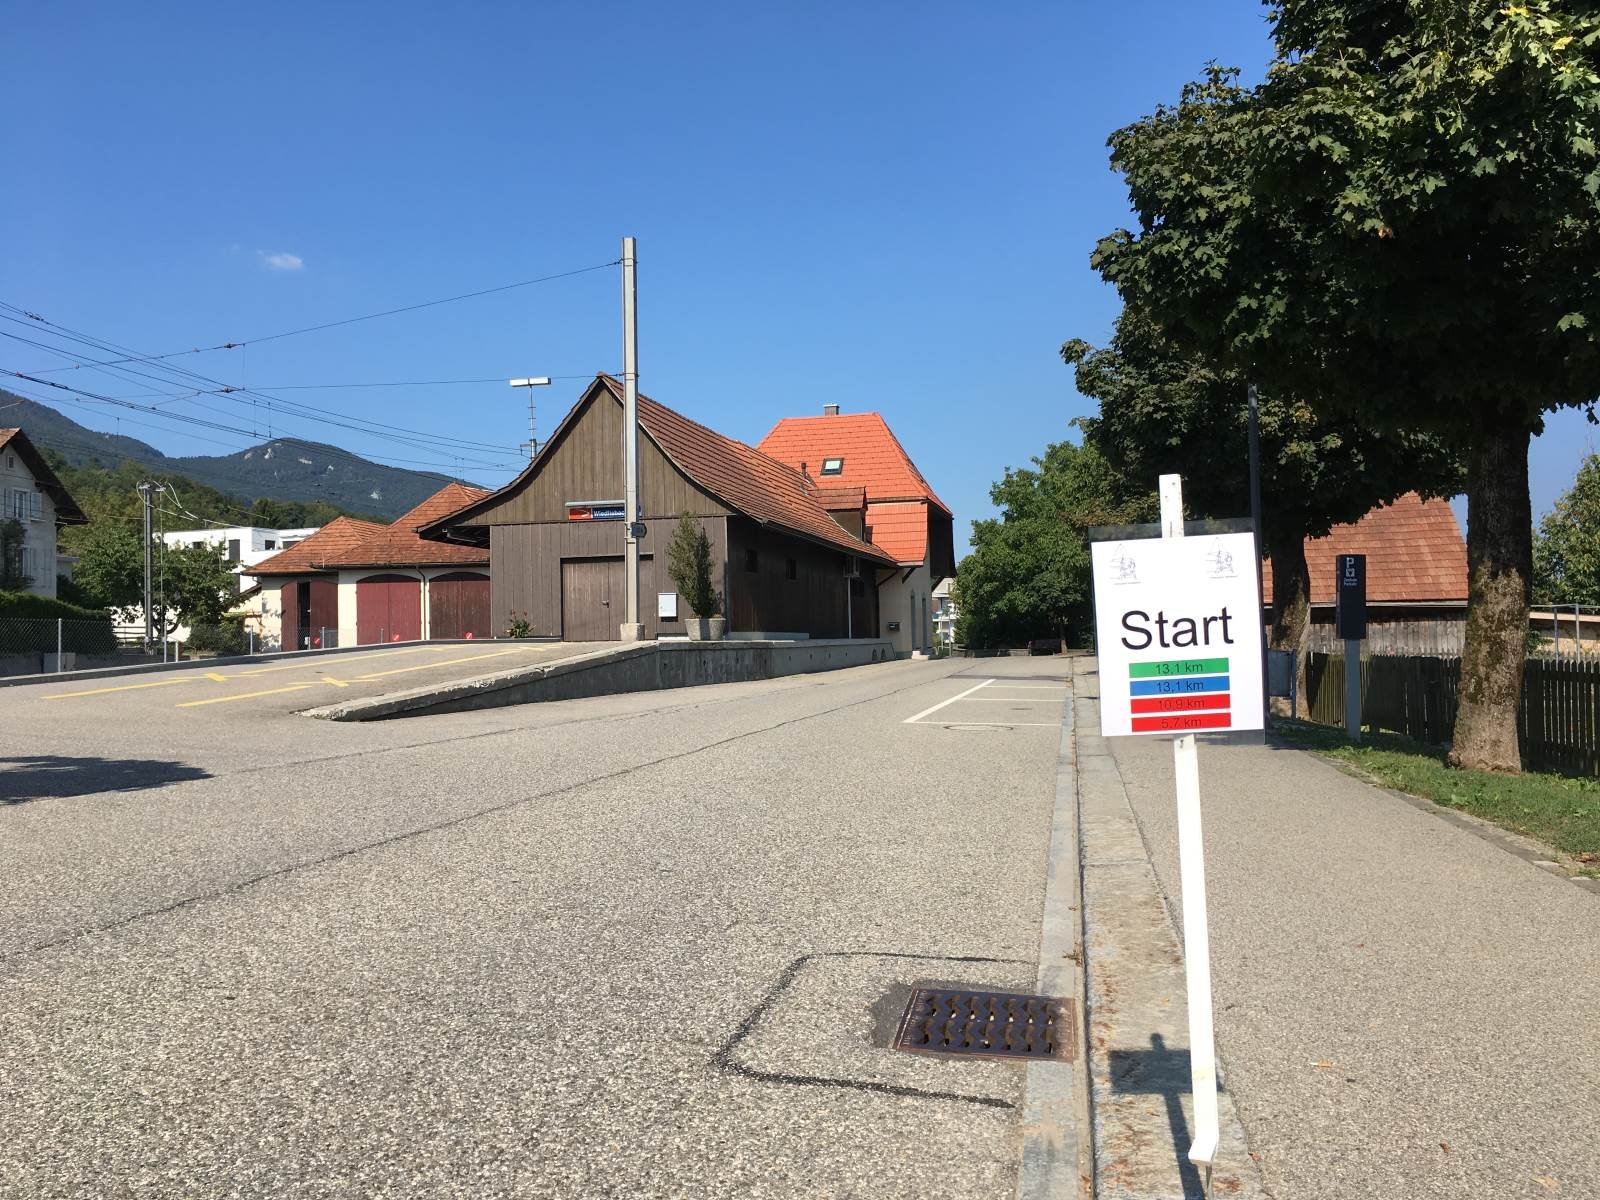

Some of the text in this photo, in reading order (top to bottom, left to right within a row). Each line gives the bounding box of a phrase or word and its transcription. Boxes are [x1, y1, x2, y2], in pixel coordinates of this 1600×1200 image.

[1346, 557, 1355, 568] P
[1121, 606, 1234, 650] Start
[1156, 662, 1203, 675] 13,1 km
[1157, 680, 1204, 693] 13,1 km
[1187, 698, 1205, 709] km
[1184, 717, 1202, 728] km
